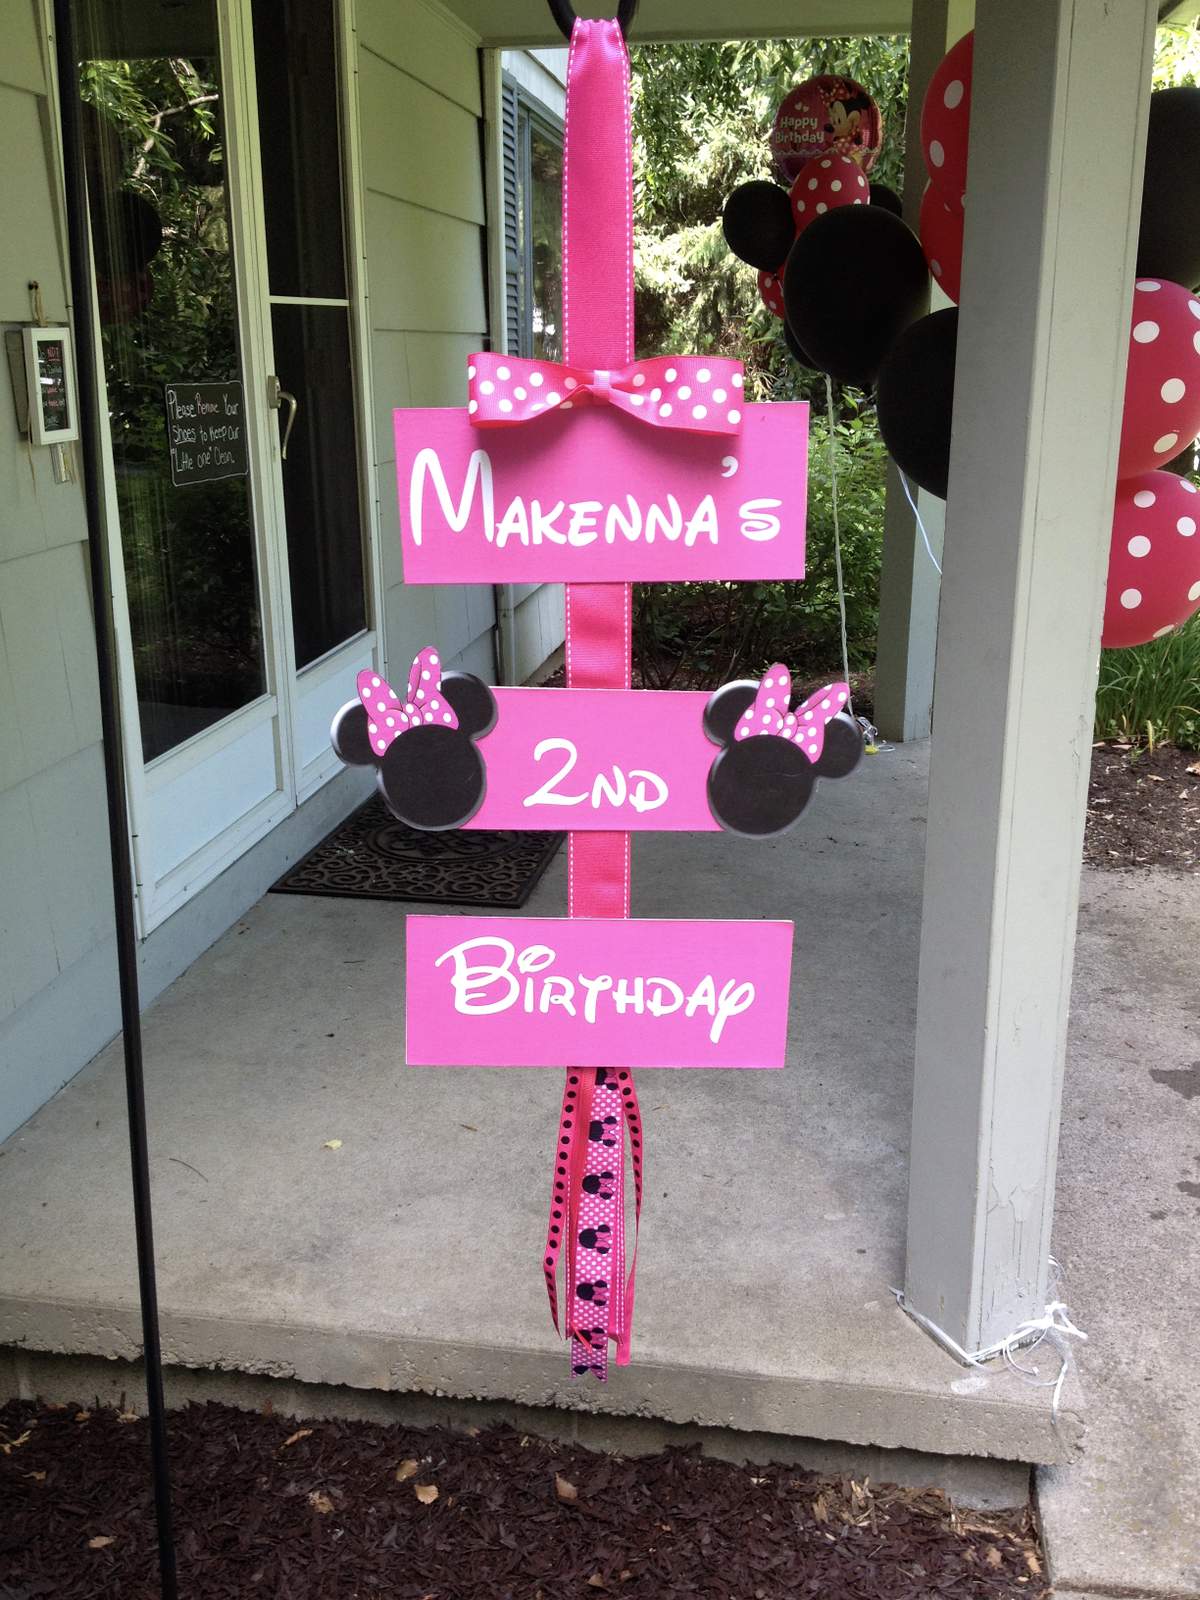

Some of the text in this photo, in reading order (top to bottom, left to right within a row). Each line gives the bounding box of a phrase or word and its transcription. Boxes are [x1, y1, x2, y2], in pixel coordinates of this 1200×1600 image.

[781, 116, 818, 130] Happy
[776, 131, 825, 143] Birthday
[167, 390, 197, 419] Please
[522, 738, 669, 813] 2ND
